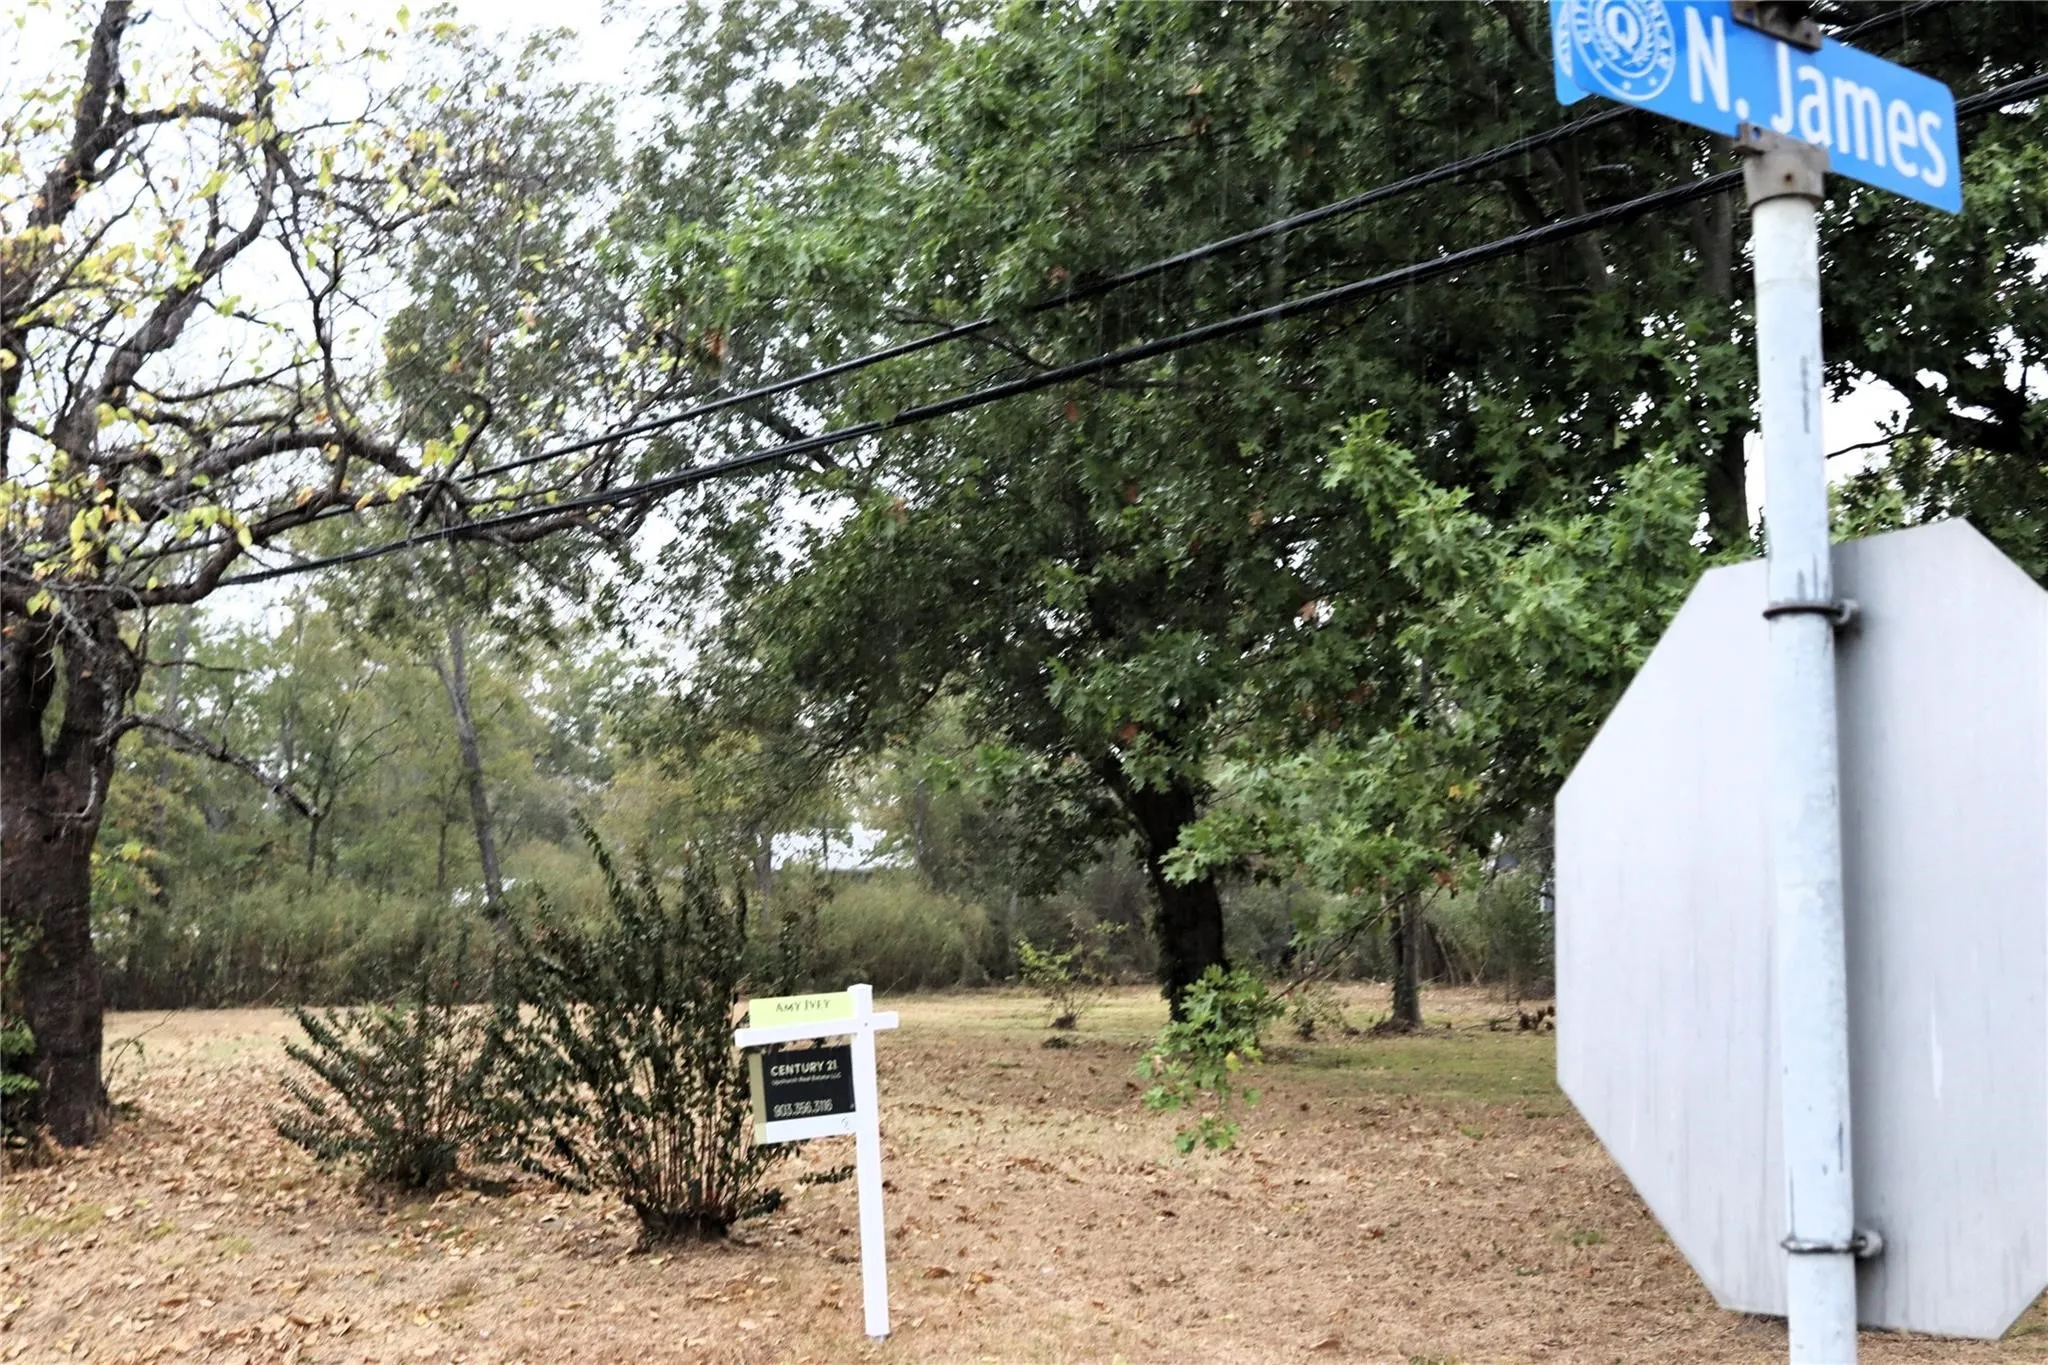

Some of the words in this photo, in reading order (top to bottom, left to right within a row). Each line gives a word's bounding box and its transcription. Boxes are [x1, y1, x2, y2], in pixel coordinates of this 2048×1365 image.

[1684, 6, 1750, 120] N.
[1771, 42, 1948, 188] James
[775, 1001, 800, 1013] AMY
[770, 1061, 824, 1077] CENTURY
[826, 1059, 838, 1072] 21
